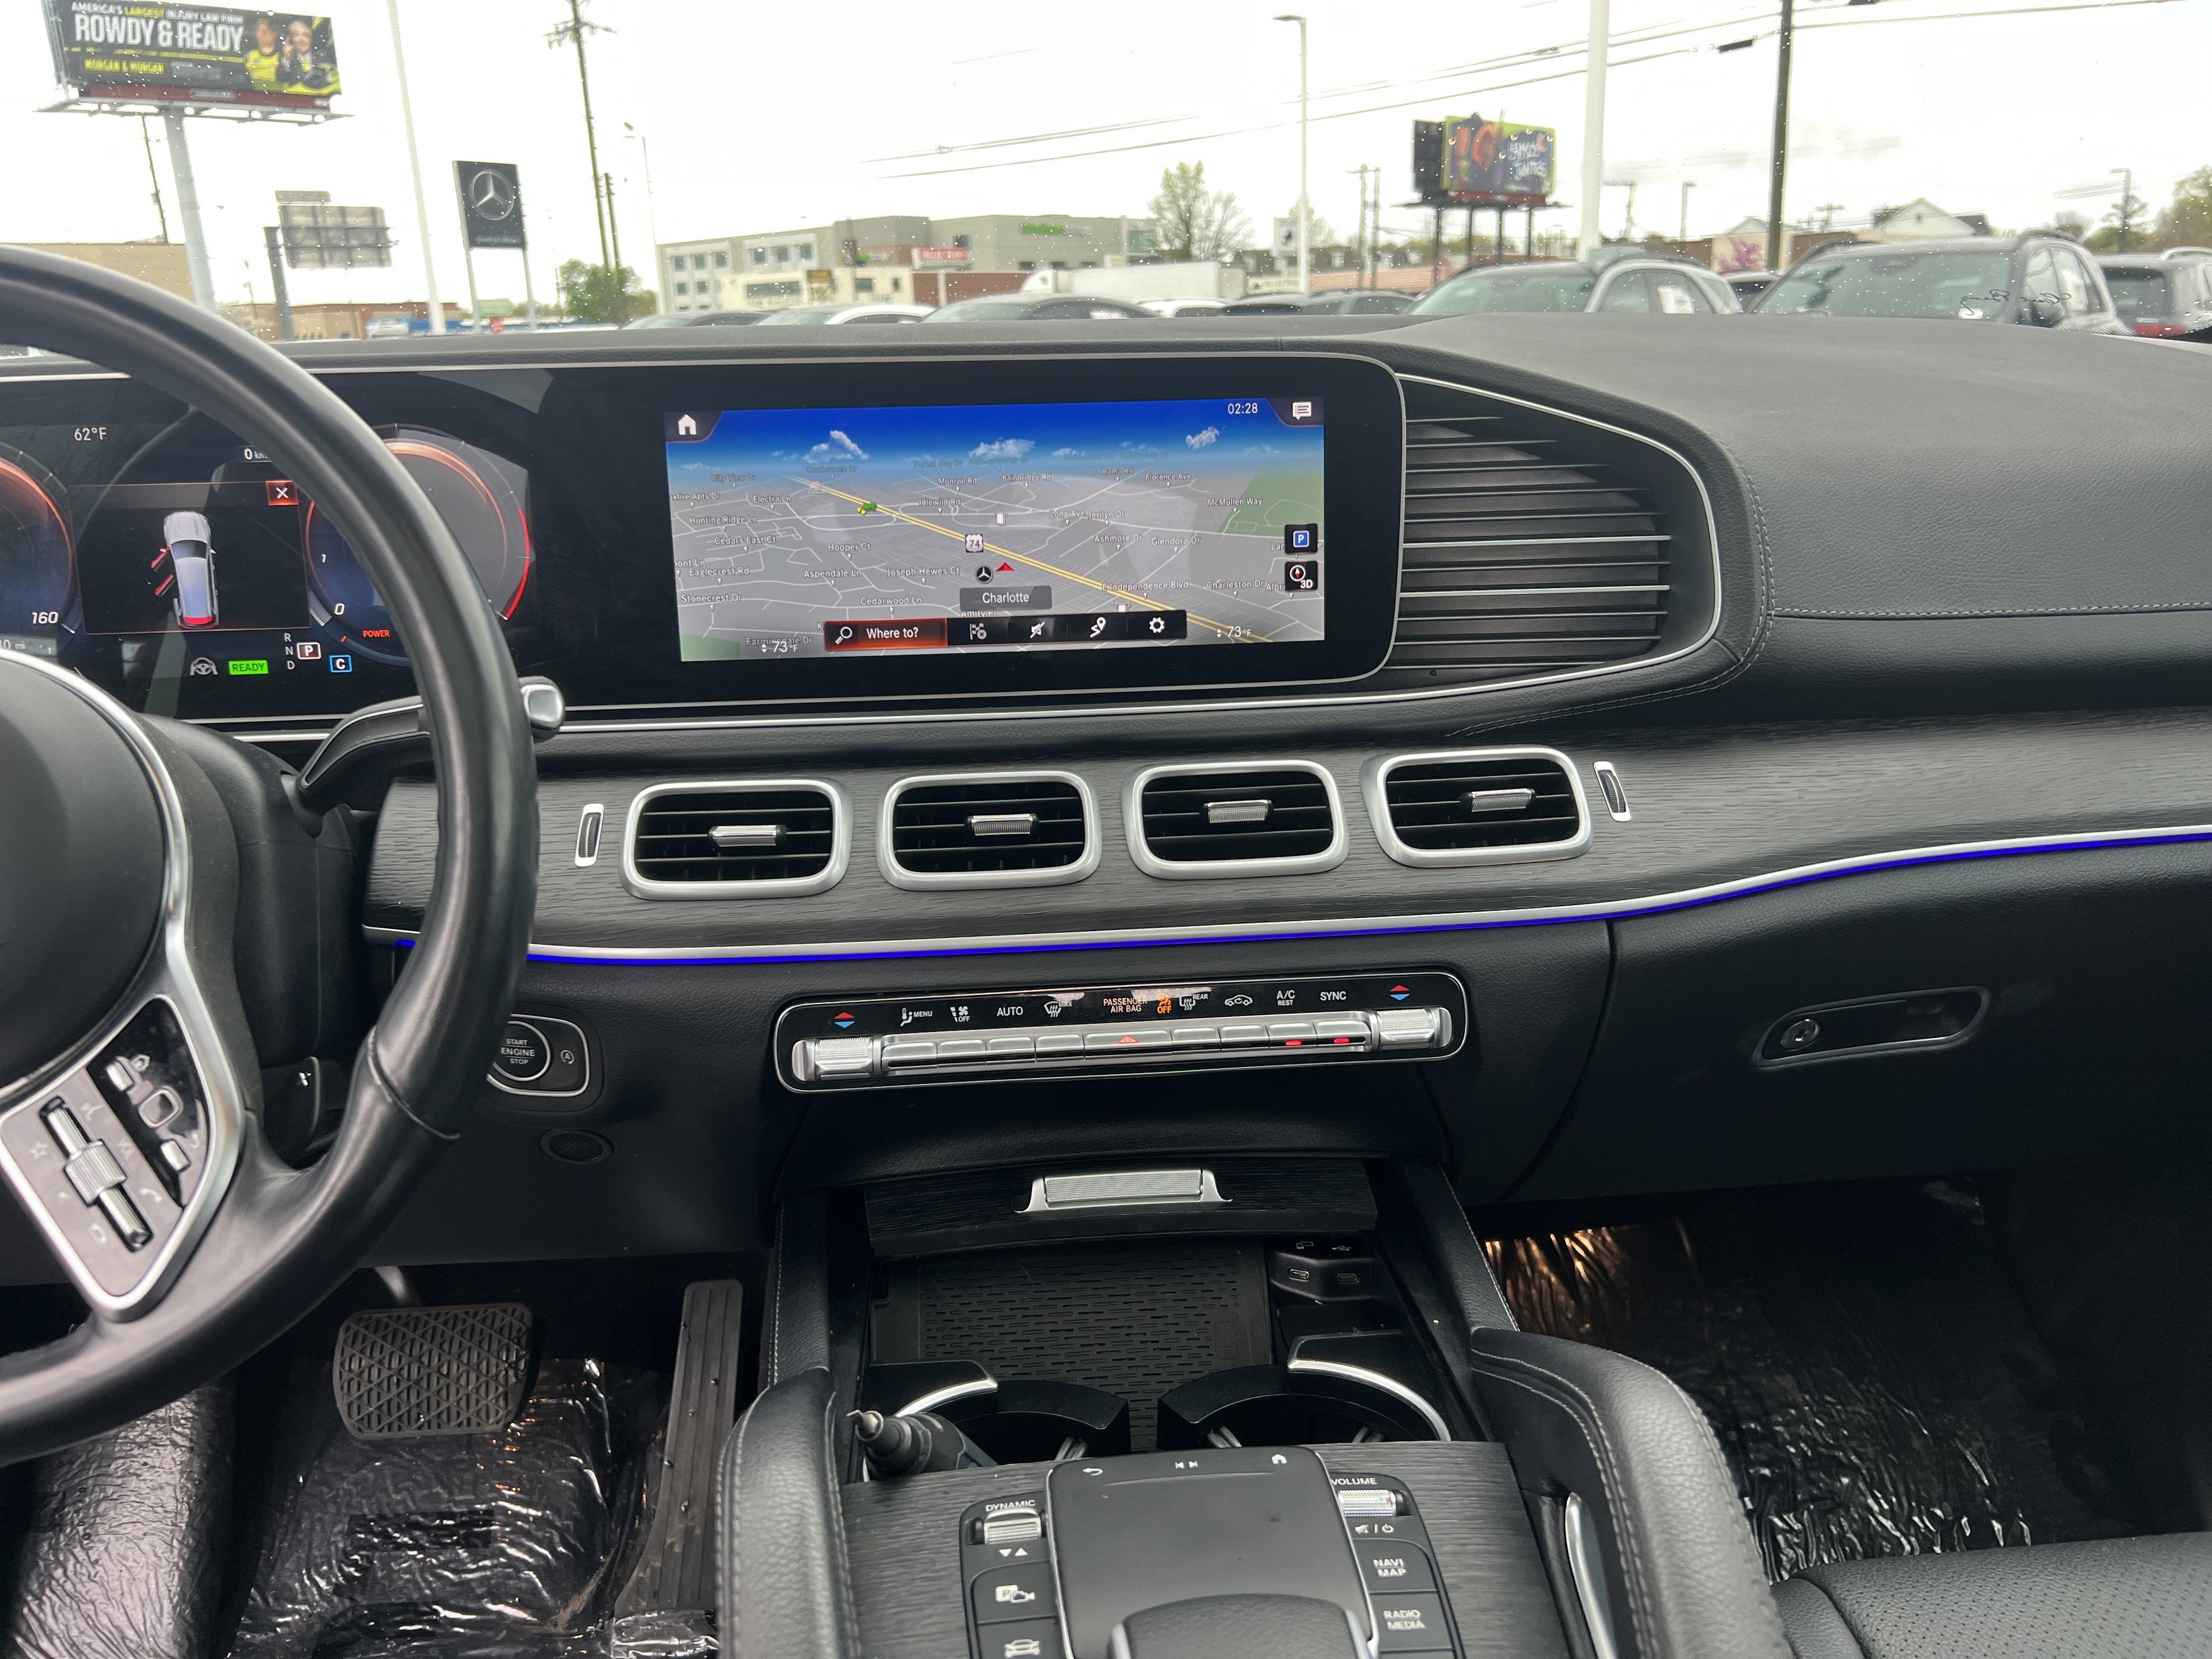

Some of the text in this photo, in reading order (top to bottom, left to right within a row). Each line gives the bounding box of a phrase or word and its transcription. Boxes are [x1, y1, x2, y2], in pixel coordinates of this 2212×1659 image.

[75, 13, 244, 53] ROWDY & READY
[1228, 403, 1258, 414] 02:28
[74, 427, 107, 441] 62°F
[244, 448, 252, 460] 0
[712, 474, 726, 483] City
[1002, 475, 1039, 483] Bainbridge
[692, 493, 709, 501] Apts
[753, 495, 779, 504] Electra
[1207, 498, 1262, 506] McMullen Way
[689, 516, 721, 526] Hunting
[723, 516, 745, 525] Ridge
[714, 535, 776, 545] Cedars East Ct
[969, 540, 980, 548] 74
[1094, 535, 1131, 543] Ashmore
[1151, 538, 1188, 546] Glendora
[828, 543, 871, 553] Hooper Ct
[321, 554, 326, 563] 1
[695, 558, 706, 567] Ln
[689, 566, 750, 578] Eaglecrest Rd
[804, 569, 848, 579] Aspendale
[887, 566, 960, 578] Joseph Hewes Ct
[1102, 581, 1188, 592] E Independence Blvd
[1206, 580, 1252, 590] Charleston
[1300, 579, 1313, 589] 3D
[681, 593, 742, 603] Stonecrest Dr
[860, 596, 922, 606] Cedarwood Ln
[983, 592, 1029, 603] Charlotte
[334, 603, 345, 615] 0
[32, 611, 59, 624] 160
[284, 633, 292, 642] R
[363, 629, 390, 638] POWER
[866, 627, 918, 639] Where to?
[746, 636, 814, 647] Farmindale Dr
[285, 646, 294, 656] N
[304, 645, 313, 657] P
[232, 663, 264, 672] READY
[287, 661, 295, 670] D
[336, 658, 346, 670] C
[1276, 990, 1295, 1000] A/C
[1320, 991, 1347, 1001] SYNC
[1103, 996, 1148, 1006] PASSENGER
[997, 1006, 1024, 1017] AUTO
[1126, 1004, 1142, 1012] BAG
[1157, 1006, 1172, 1014] OFF
[500, 1047, 536, 1057] ENGINE
[1331, 1477, 1378, 1485] VOLUME
[986, 1499, 1036, 1512] DYNAMIC
[1373, 1559, 1404, 1567] NAVI
[1378, 1568, 1407, 1577] MAP
[1383, 1609, 1422, 1619] RADIO
[1387, 1620, 1426, 1630] MEDIA
